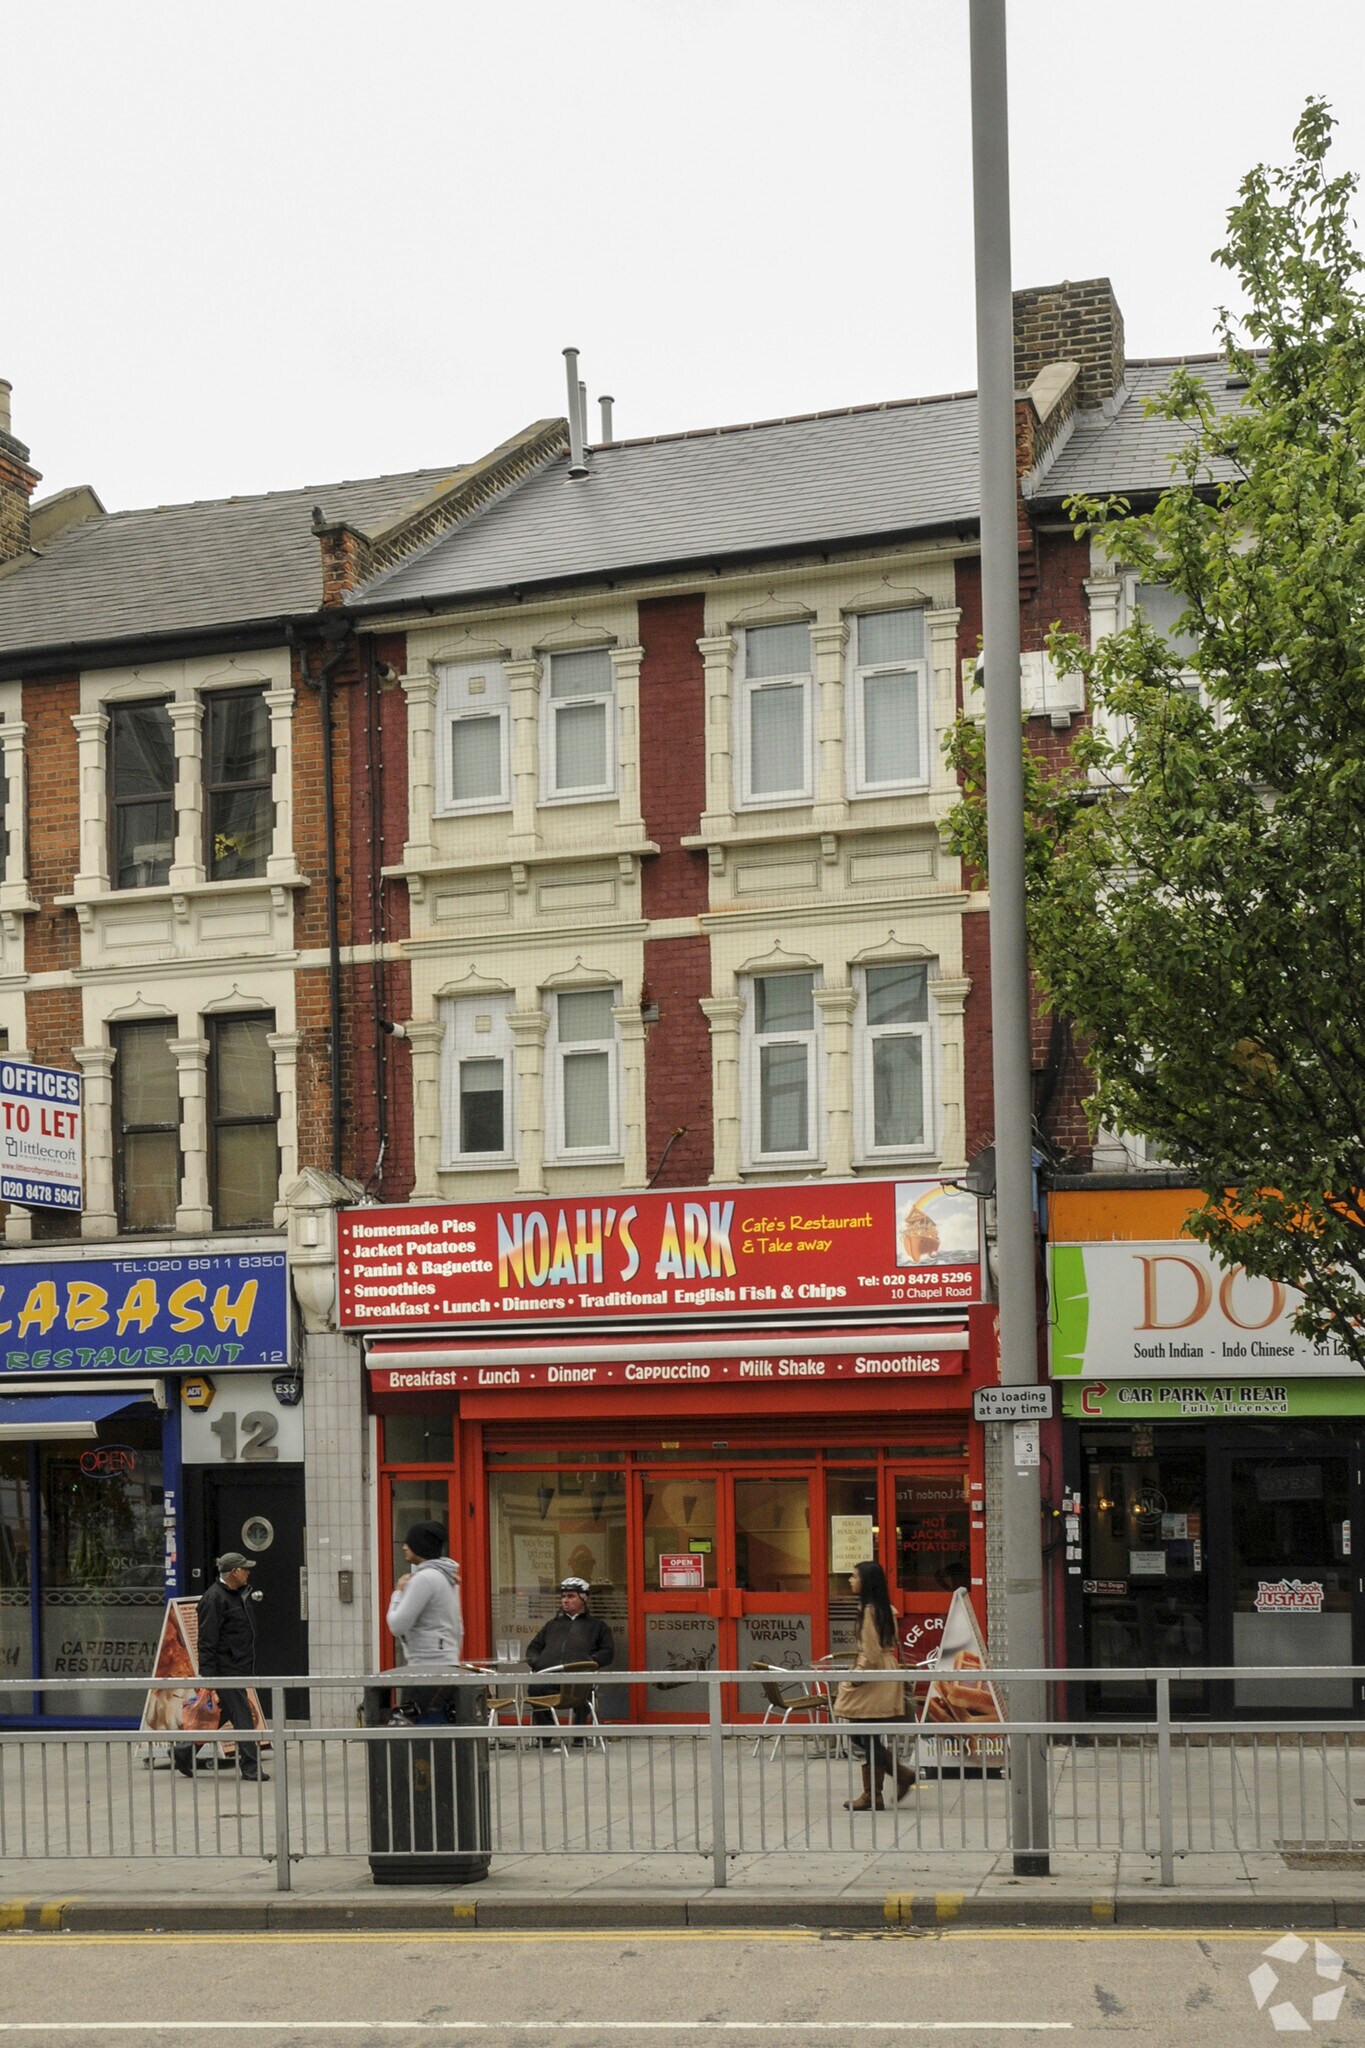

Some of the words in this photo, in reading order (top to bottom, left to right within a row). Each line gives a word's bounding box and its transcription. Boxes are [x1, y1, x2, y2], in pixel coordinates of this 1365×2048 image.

[2, 1065, 79, 1101] OFFICES
[1, 1101, 30, 1133] TO
[41, 1108, 78, 1140] LET
[19, 1140, 77, 1161] littlecroft
[2, 1180, 23, 1198] 020
[25, 1184, 52, 1202] 8478
[54, 1187, 80, 1206] 5947
[352, 1221, 439, 1239] Homemade
[442, 1218, 476, 1234] Pies
[741, 1216, 786, 1234] Cafe's
[790, 1212, 873, 1231] Restaurant
[353, 1243, 403, 1258] Jacket
[406, 1240, 476, 1256] Potatoes
[496, 1205, 640, 1289] NOAH'S
[655, 1200, 738, 1280] ARK
[741, 1239, 755, 1254] &
[757, 1237, 793, 1254] Take
[796, 1238, 833, 1253] away
[112, 1259, 182, 1274] TEL:020
[188, 1257, 232, 1271] 8911
[238, 1255, 285, 1269] 8350
[353, 1261, 402, 1278] Panini
[406, 1261, 418, 1276] &
[421, 1258, 493, 1277] Baguette
[857, 1275, 880, 1288] Tel:
[882, 1275, 906, 1286] 020
[908, 1273, 939, 1285] 8478
[941, 1272, 972, 1284] 5296
[354, 1281, 436, 1298] Smoothies
[890, 1288, 904, 1300] 10
[906, 1286, 944, 1302] Chapel
[945, 1285, 973, 1297] Road
[354, 1300, 430, 1318] Breakfast
[442, 1298, 491, 1315] Lunch
[502, 1295, 566, 1312] Dinners
[578, 1290, 668, 1308] Traditional
[674, 1287, 736, 1306] English
[739, 1285, 777, 1301] Fish
[780, 1285, 794, 1299] &
[797, 1283, 847, 1301] Chips
[6, 1342, 244, 1370] RESTAURANT
[259, 1350, 283, 1363] 12
[1134, 1343, 1166, 1358] South
[1169, 1342, 1204, 1358] Indian
[1222, 1342, 1247, 1357] Indo
[1251, 1341, 1295, 1357] Chinese
[1313, 1341, 1330, 1356] Sri
[389, 1370, 457, 1388] Breakfast
[477, 1367, 520, 1384] Lunch
[547, 1366, 597, 1383] Dinner
[625, 1361, 711, 1381] Cappuccino
[740, 1360, 773, 1377] Milk
[778, 1358, 825, 1376] Shake
[855, 1356, 940, 1374] Smoothies
[187, 1387, 201, 1396] ADT
[275, 1384, 296, 1394] ESS
[1118, 1387, 1153, 1402] CAR
[1159, 1387, 1207, 1402] PARK
[1212, 1386, 1235, 1401] AT
[1240, 1386, 1287, 1401] REAR
[980, 1392, 998, 1403] No
[1001, 1391, 1046, 1405] loading
[979, 1406, 991, 1416] at
[995, 1405, 1017, 1417] any
[1021, 1402, 1048, 1414] time
[1182, 1402, 1218, 1415] Fully
[1224, 1402, 1288, 1413] Licensed
[211, 1411, 279, 1460] 12
[1026, 1443, 1033, 1453] 3
[80, 1451, 135, 1471] OPEN
[922, 1516, 945, 1527] HOT
[911, 1529, 958, 1540] JACKET
[903, 1541, 967, 1552] POTATOES
[1261, 1584, 1286, 1592] Don't
[1295, 1583, 1319, 1592] cook
[1258, 1593, 1291, 1606] JUST
[1294, 1593, 1320, 1606] EAT
[649, 1619, 716, 1632] DESSERTS
[743, 1619, 805, 1631] TORTILLA
[751, 1630, 798, 1642] WRAPS
[903, 1624, 924, 1648] ICE
[61, 1641, 158, 1656] CARIBBEAN
[55, 1658, 155, 1672] RESTAURA
